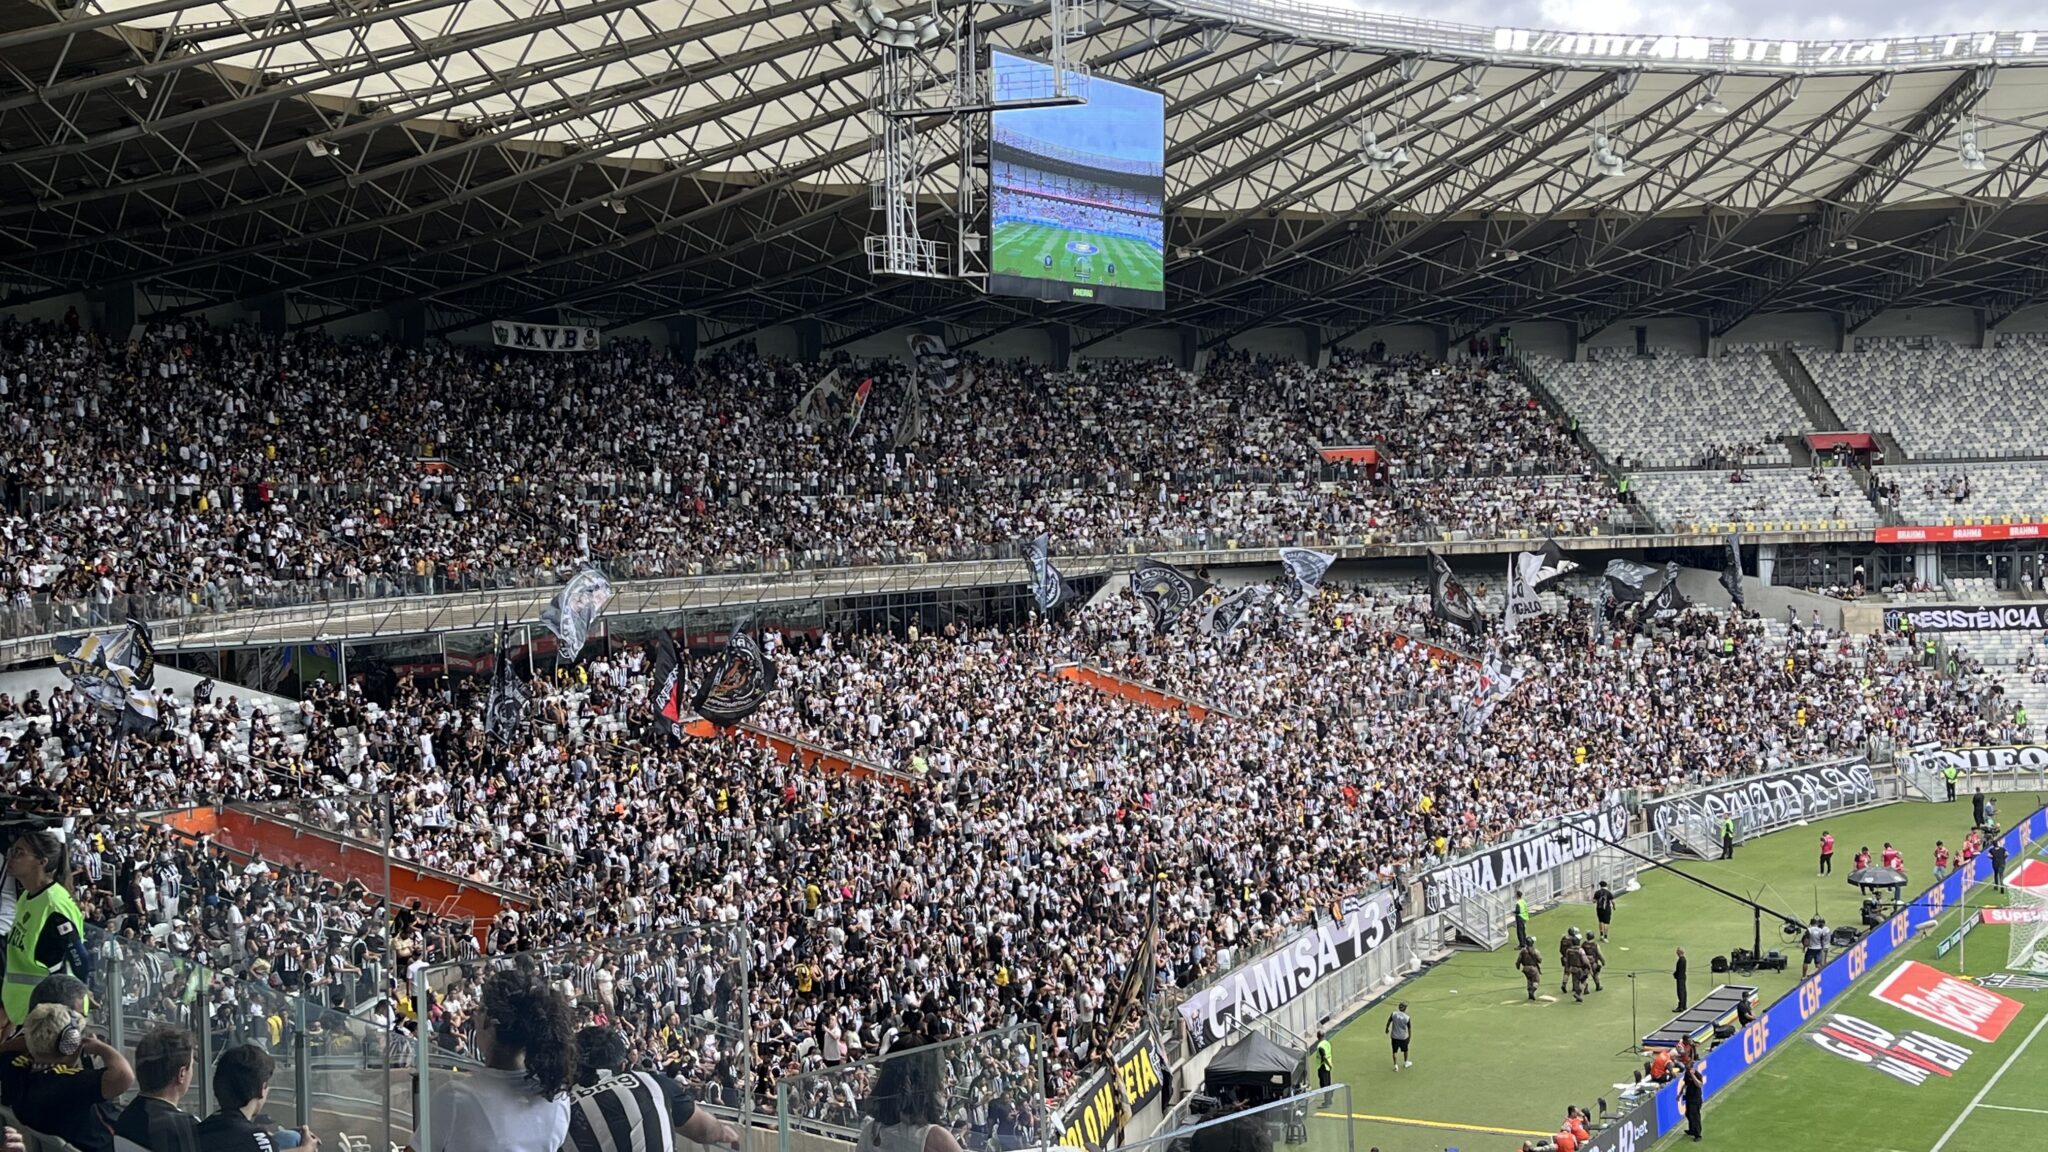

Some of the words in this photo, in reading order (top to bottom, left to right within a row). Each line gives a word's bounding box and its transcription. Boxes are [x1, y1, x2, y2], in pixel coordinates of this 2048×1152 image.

[1897, 530, 1926, 539] BRAHMA
[1953, 529, 1982, 538] BRAHMA
[2009, 526, 2039, 536] BRAHMA
[1907, 606, 2042, 629] RESISTÊNCIA
[1501, 813, 1613, 886] ALVINEGRA
[1890, 910, 1909, 947] CBF
[1209, 926, 1341, 1039] CAMISA
[1347, 902, 1384, 958] 13
[1848, 940, 1868, 981] CBF
[1799, 975, 1822, 1020] CBF
[1901, 977, 2003, 1031] Betano
[1743, 1014, 1769, 1064] CBF
[577, 1075, 637, 1098] bmg
[1877, 1056, 1931, 1086] NA
